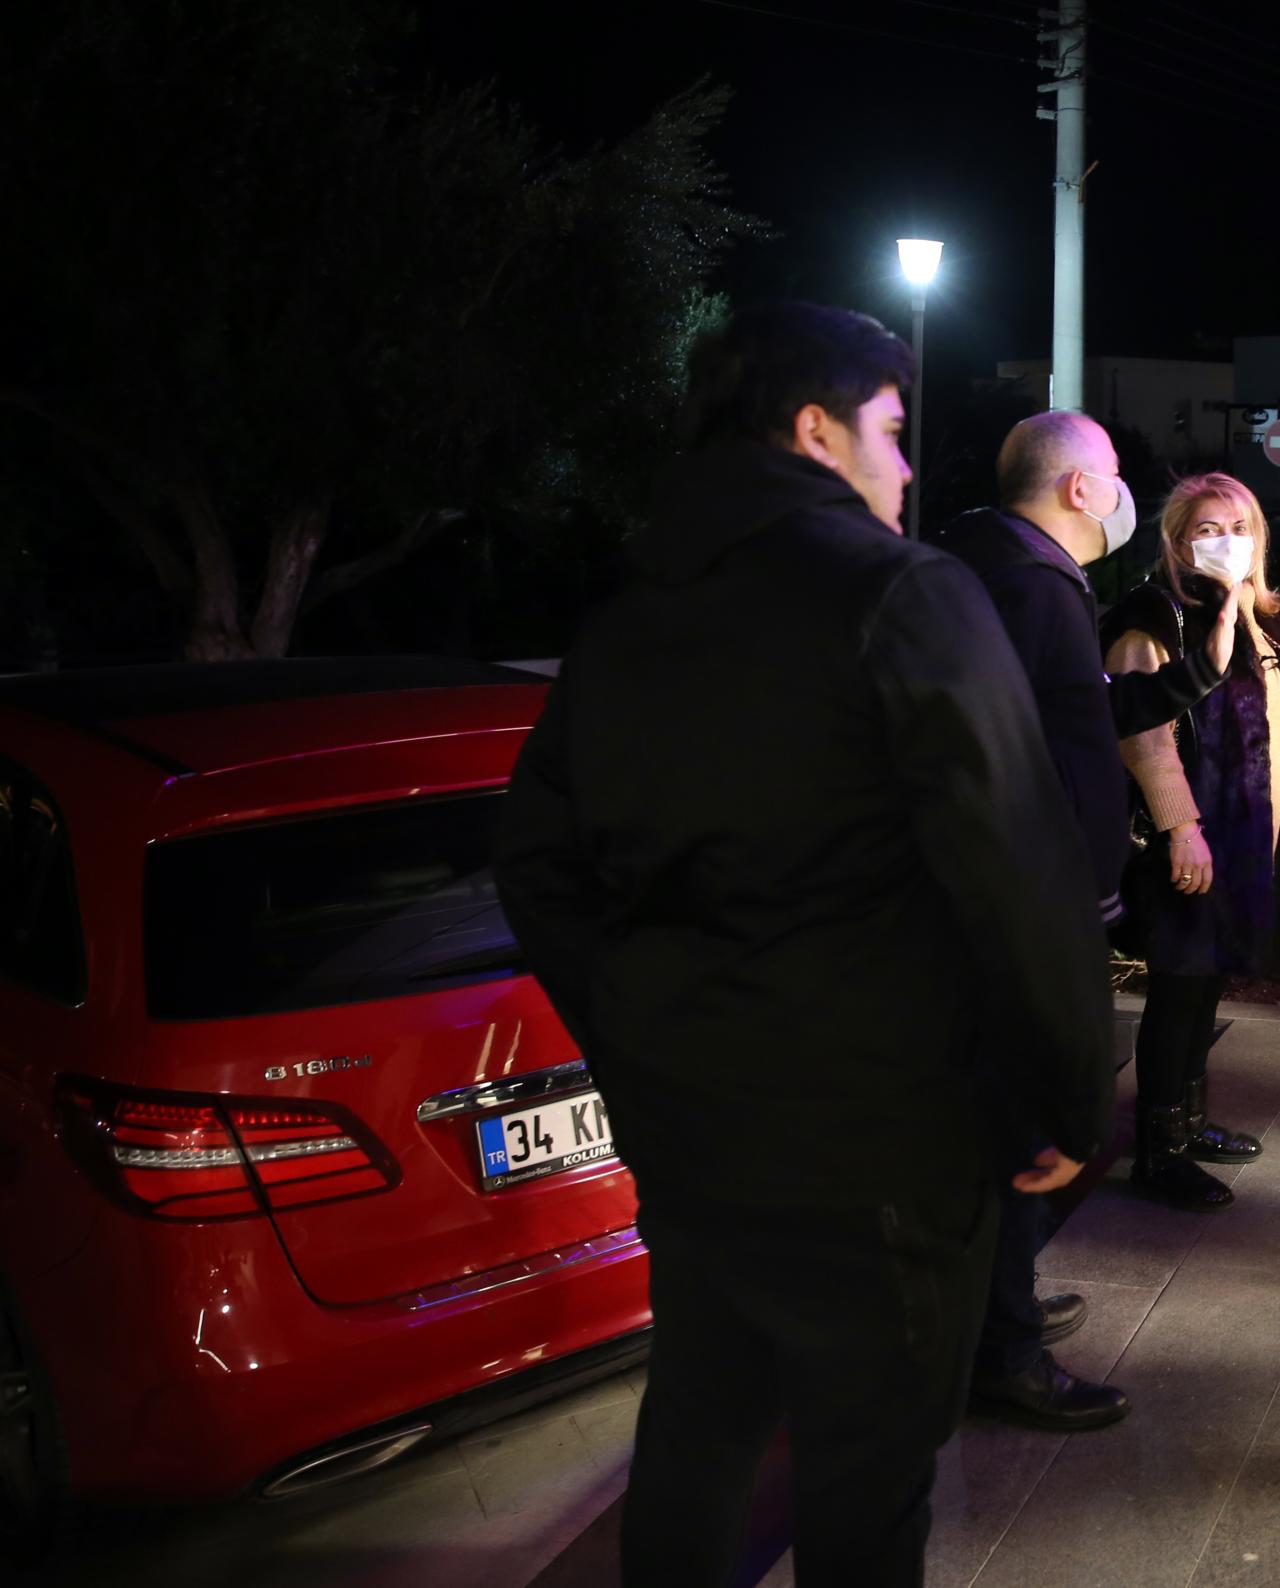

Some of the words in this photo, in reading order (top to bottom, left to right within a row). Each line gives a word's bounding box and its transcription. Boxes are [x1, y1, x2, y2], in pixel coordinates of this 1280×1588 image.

[507, 1115, 553, 1163] 34
[487, 1149, 507, 1166] TR
[563, 1143, 615, 1167] KOLUM
